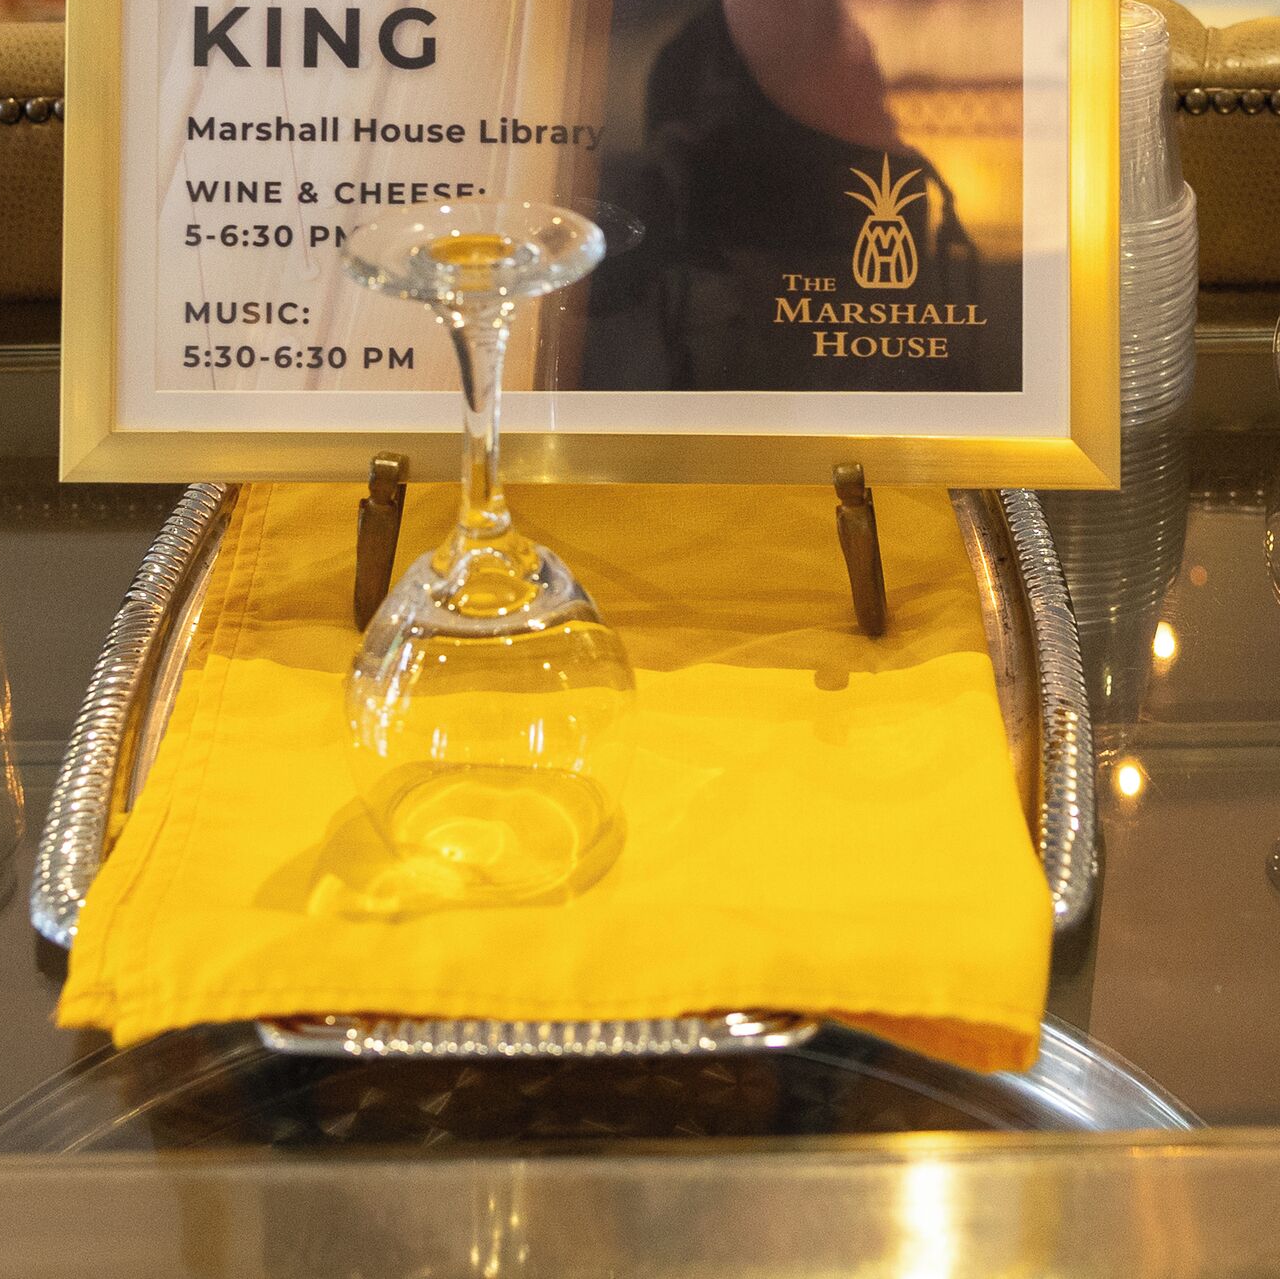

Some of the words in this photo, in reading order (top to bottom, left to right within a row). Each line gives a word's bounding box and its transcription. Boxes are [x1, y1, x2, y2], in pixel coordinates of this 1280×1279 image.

[192, 5, 439, 71] KING
[187, 116, 339, 143] Marshall
[354, 118, 466, 145] House
[479, 118, 603, 151] Library
[186, 180, 282, 203] WINE
[298, 181, 319, 204] &
[184, 224, 294, 248] 5-6:30
[782, 274, 837, 292] THE
[184, 301, 310, 325] MUSIC:
[773, 297, 988, 326] MARSHALL
[182, 345, 347, 369] 5:30-6:30
[363, 346, 415, 370] PM
[812, 331, 949, 359] HOUSE
